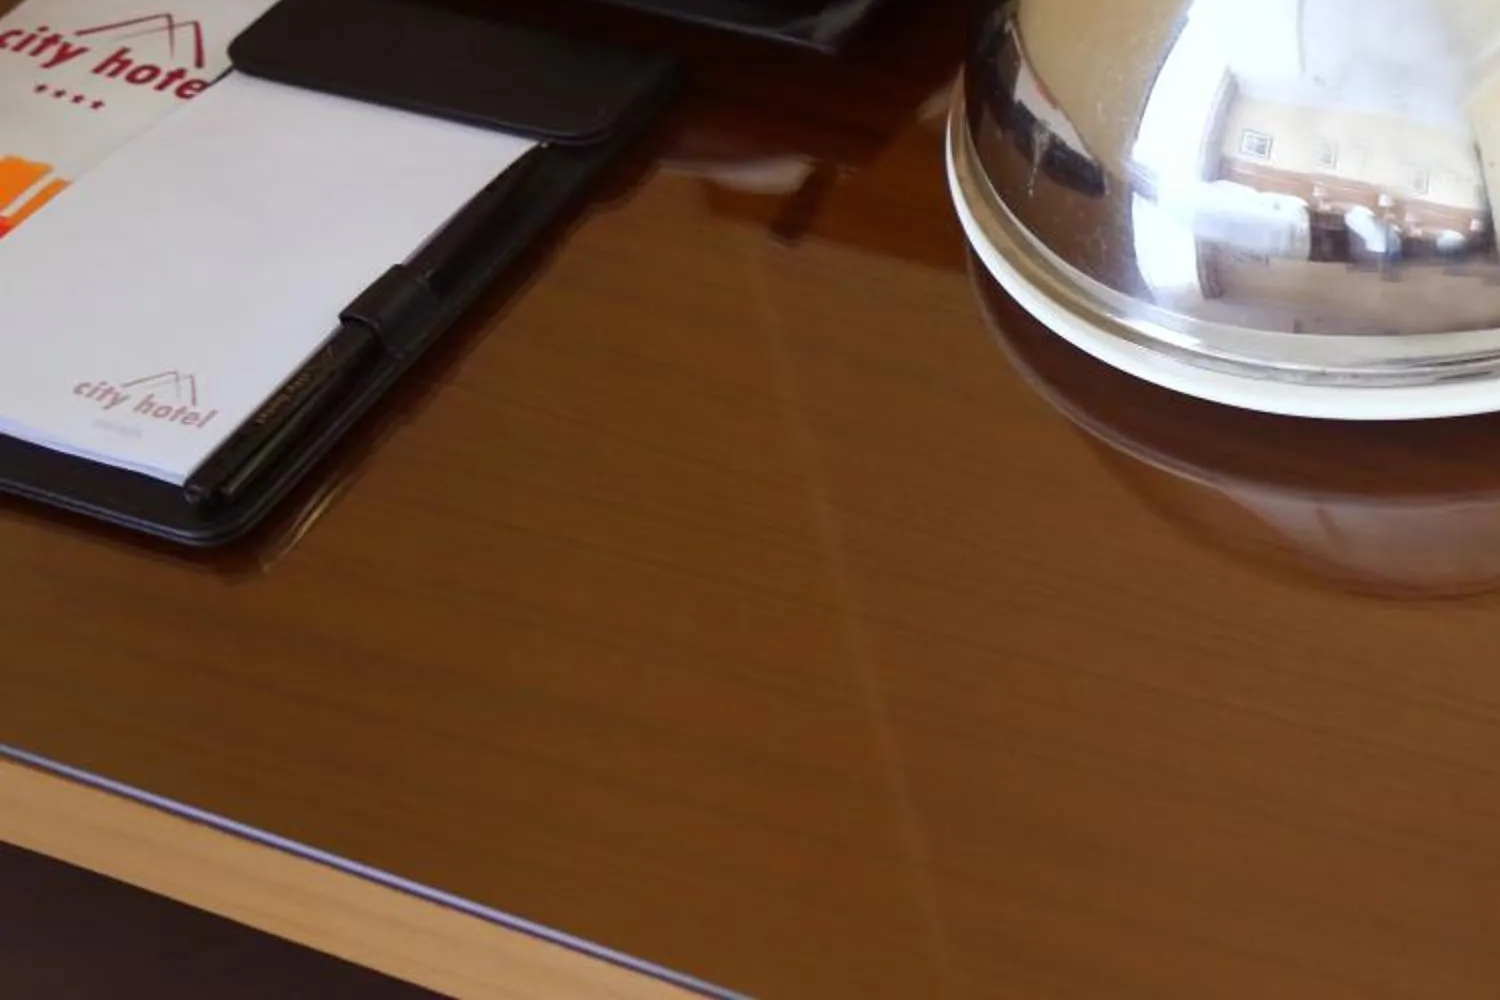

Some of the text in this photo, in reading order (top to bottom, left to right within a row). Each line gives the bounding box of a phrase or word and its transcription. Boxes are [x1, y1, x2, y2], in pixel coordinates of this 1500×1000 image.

[0, 25, 212, 101] city hote
[73, 380, 131, 412] city
[133, 392, 219, 429] hotel
